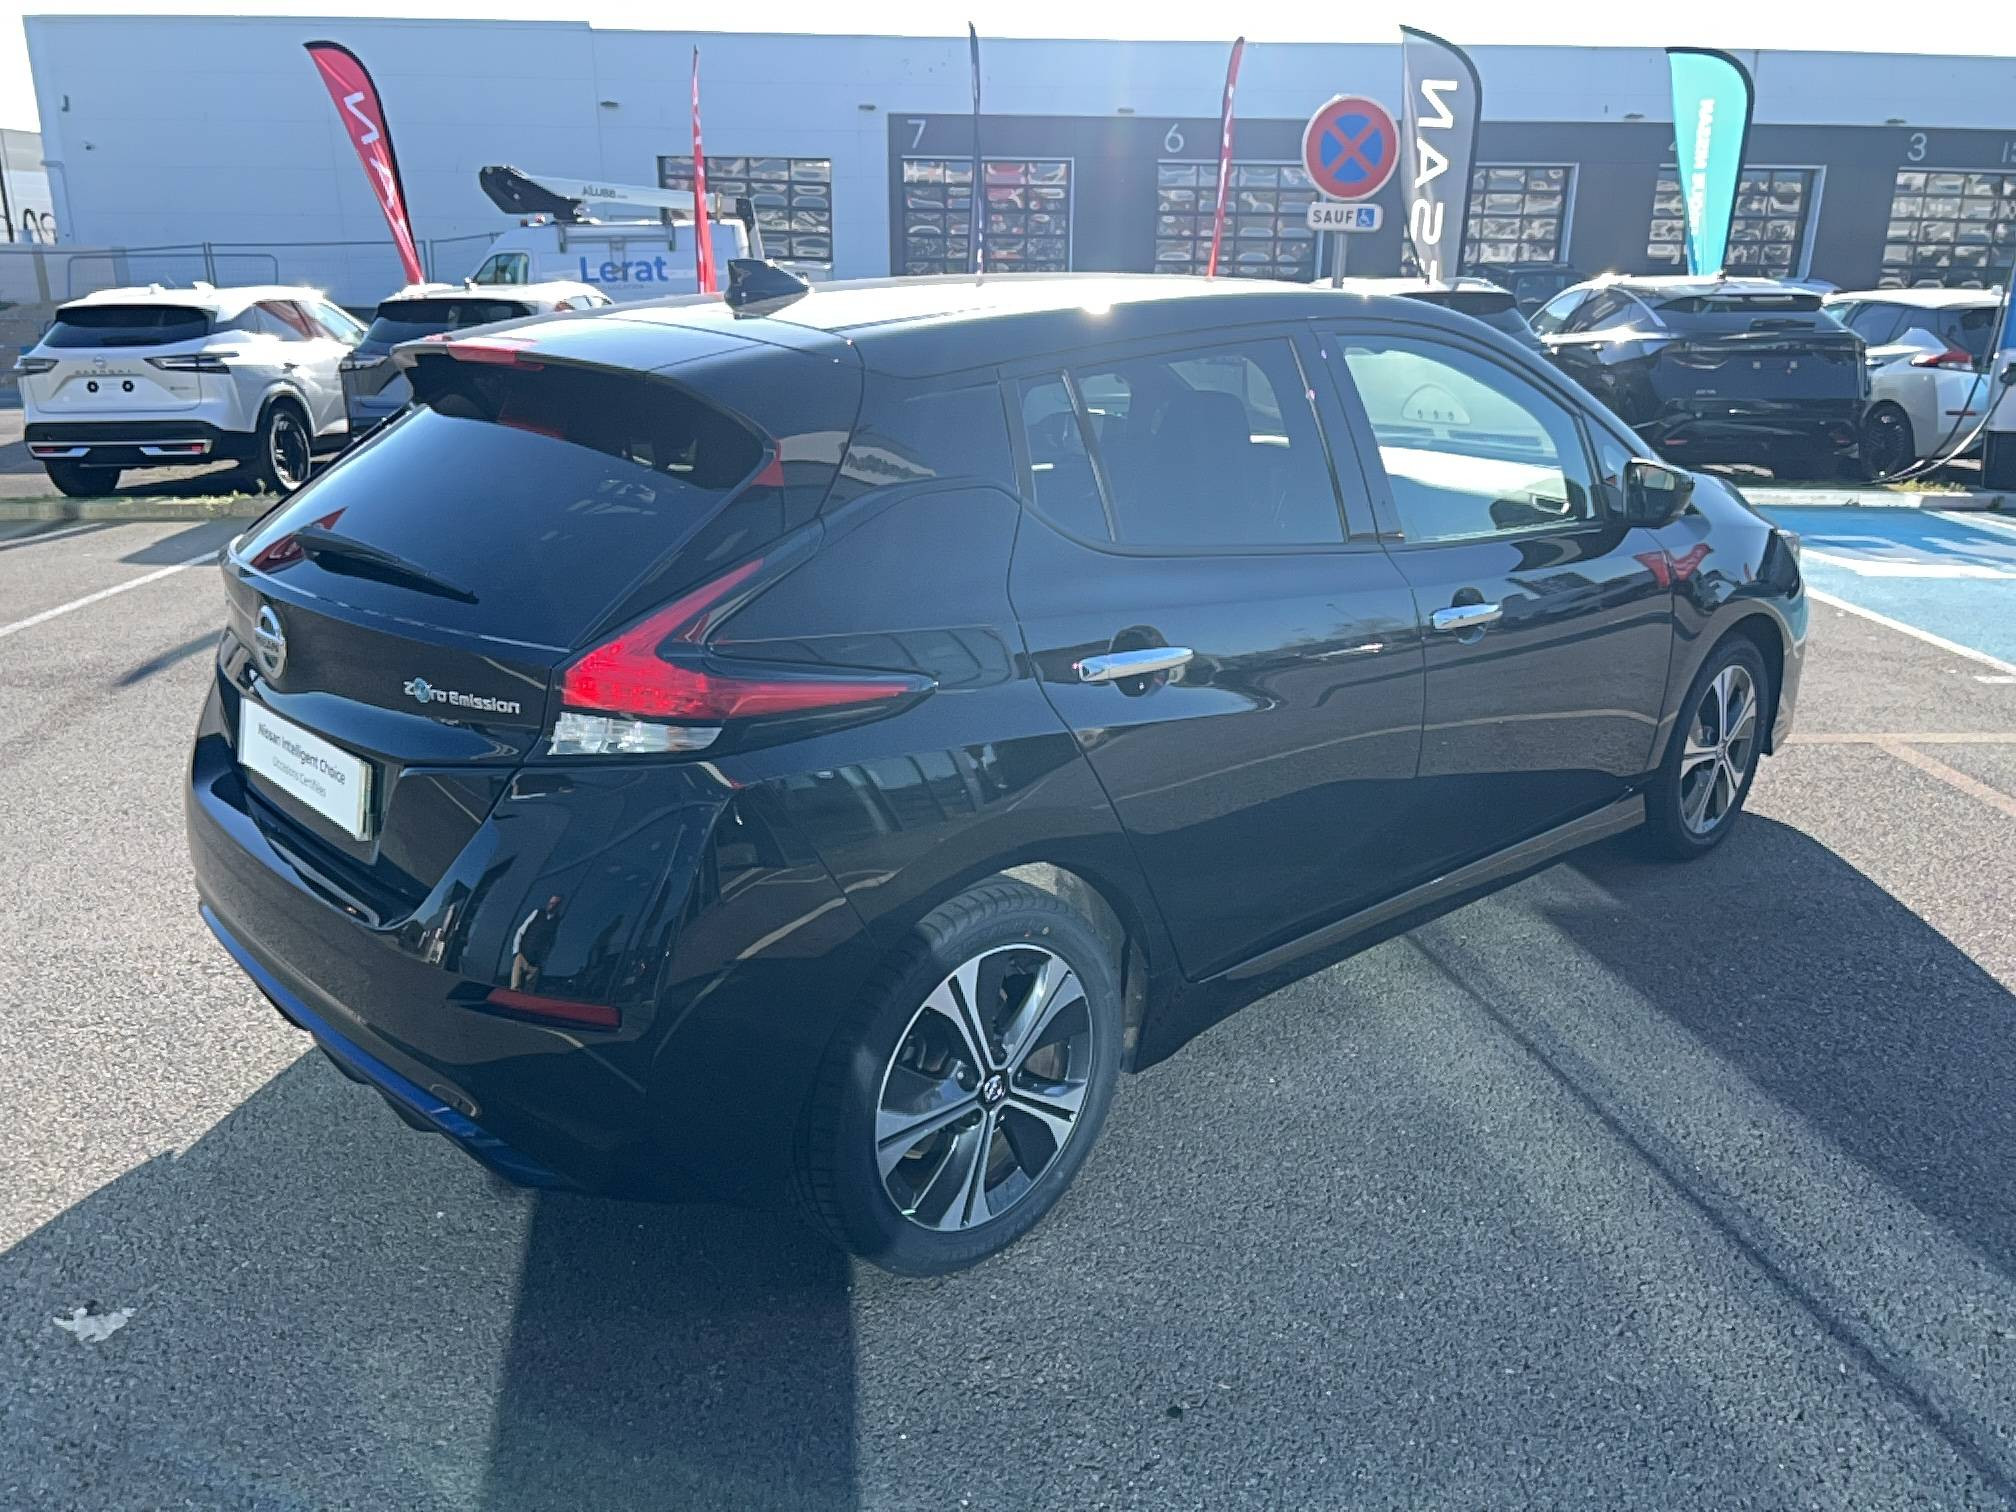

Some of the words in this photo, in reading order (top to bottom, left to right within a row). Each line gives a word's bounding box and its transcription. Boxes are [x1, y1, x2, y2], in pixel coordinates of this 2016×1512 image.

[907, 119, 926, 149] 7
[1164, 123, 1184, 153] 6
[1907, 132, 1928, 161] 3
[1312, 210, 1354, 224] SAUF
[580, 256, 669, 283] Lerat
[448, 690, 520, 715] Emission
[281, 736, 318, 769] Intelligent
[319, 758, 346, 785] Choice
